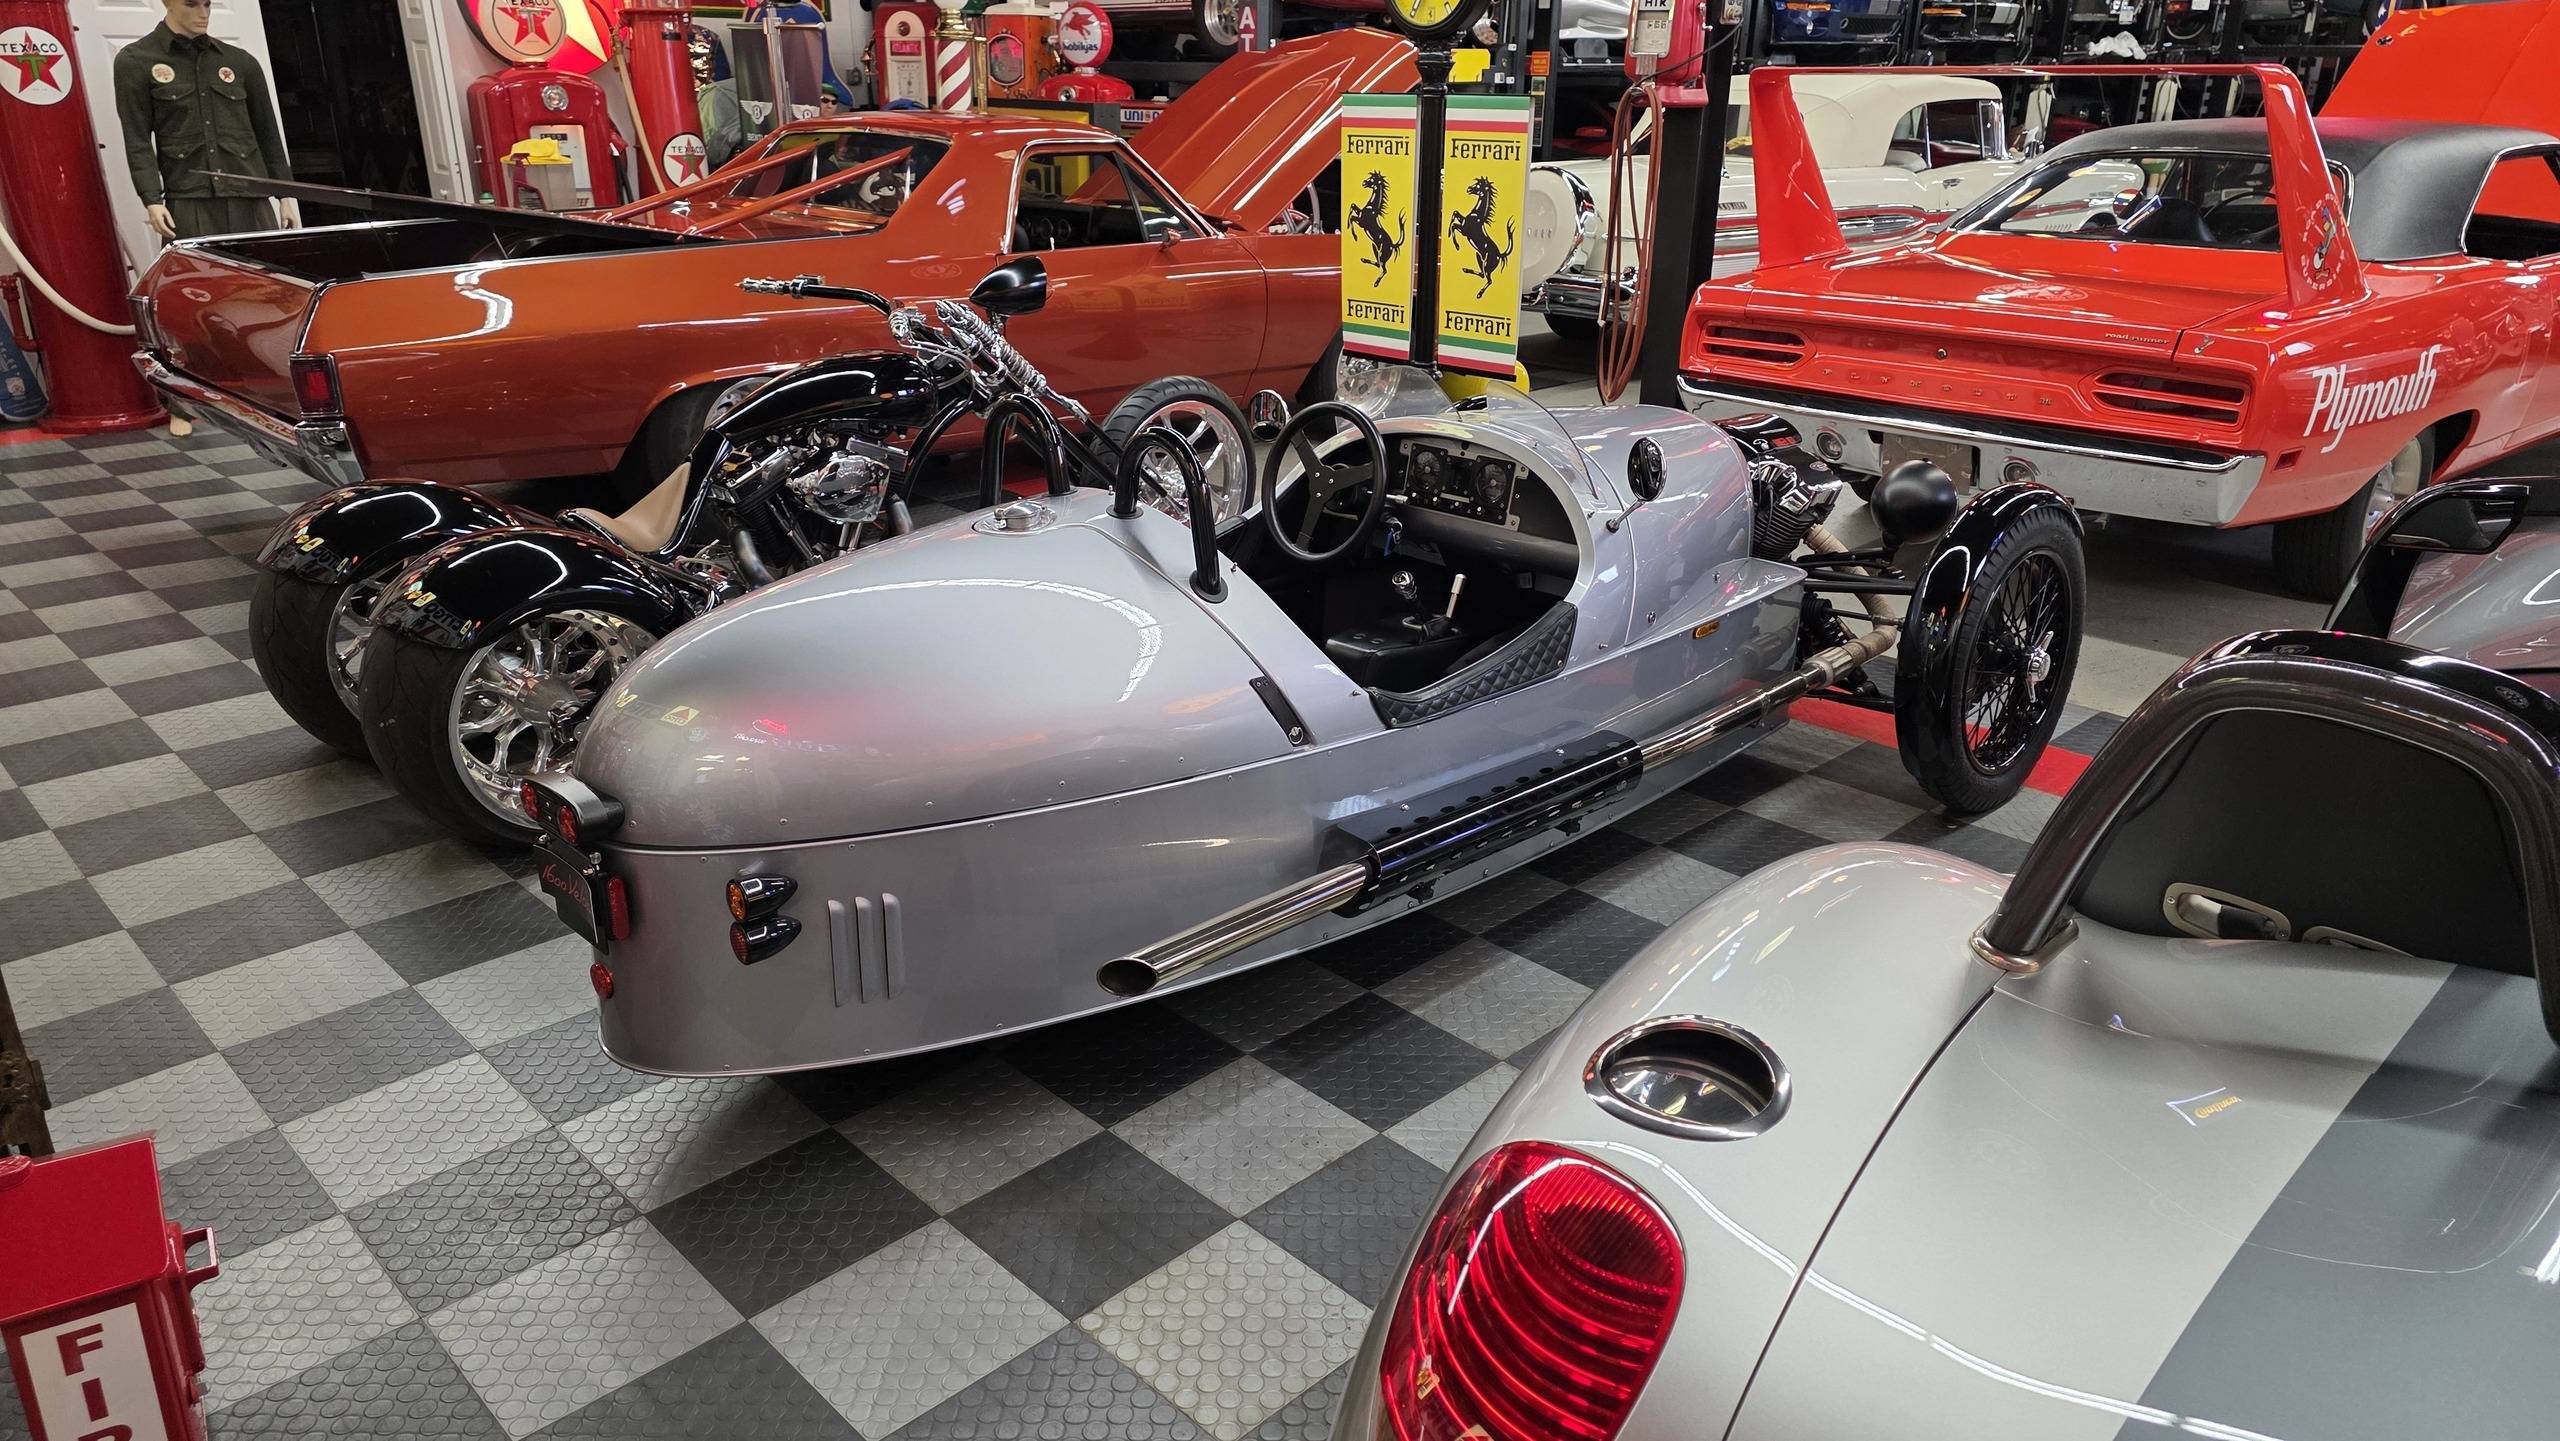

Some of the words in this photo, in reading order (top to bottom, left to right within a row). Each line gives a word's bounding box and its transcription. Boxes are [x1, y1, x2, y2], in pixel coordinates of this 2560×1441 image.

[0, 43, 58, 53] TEXACO
[671, 145, 705, 154] TEXACO
[1346, 134, 1410, 156] Ferrari
[1450, 138, 1521, 161] Ferrari
[1346, 298, 1405, 324] Ferrari
[1444, 310, 1512, 337] Ferrari
[2303, 343, 2443, 454] Plymouth
[542, 862, 567, 891] 1600
